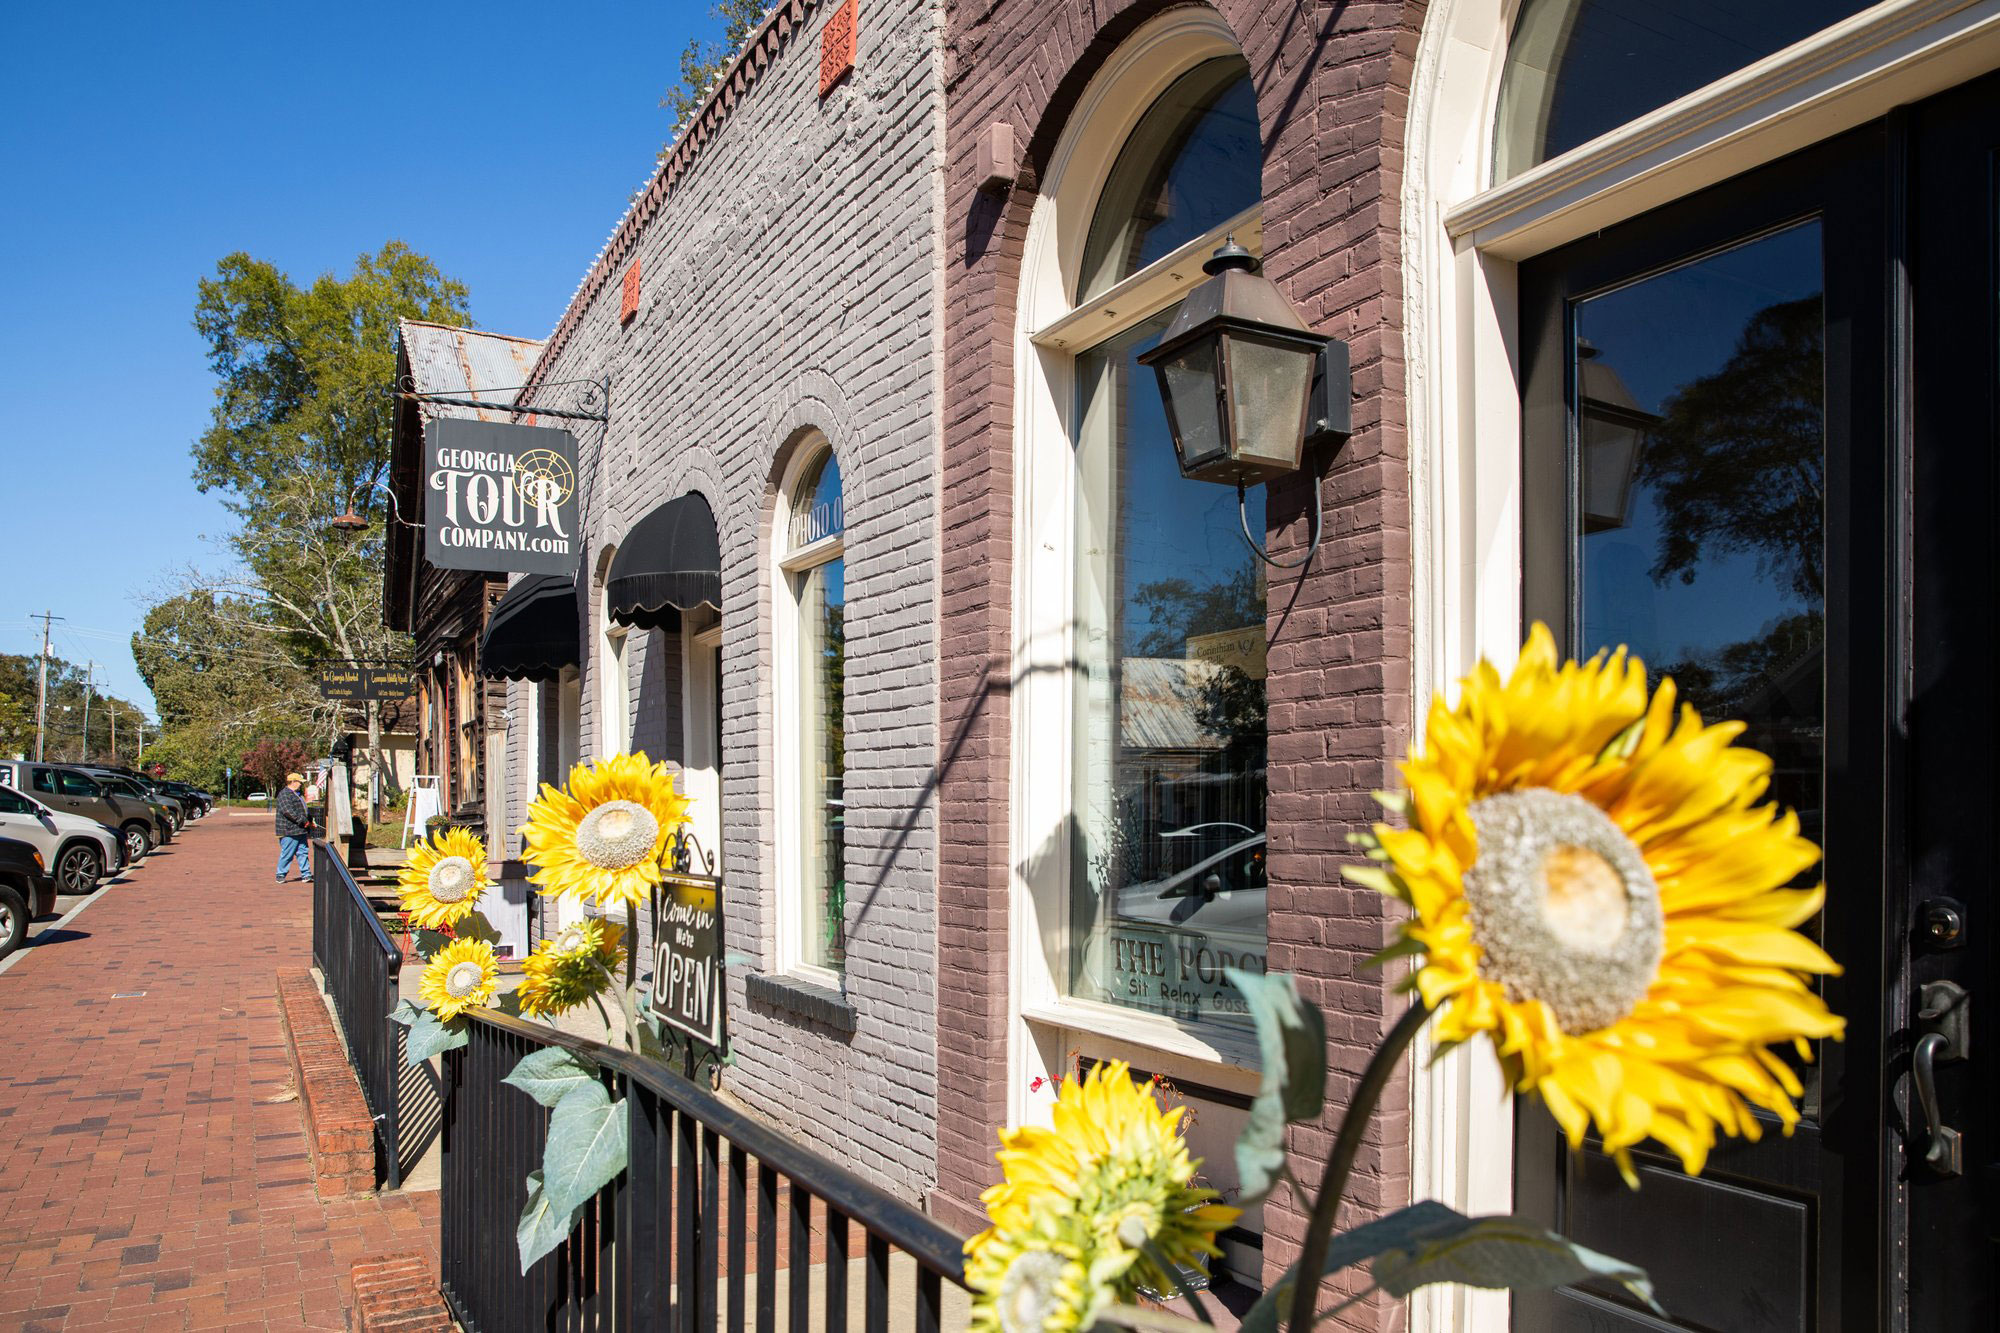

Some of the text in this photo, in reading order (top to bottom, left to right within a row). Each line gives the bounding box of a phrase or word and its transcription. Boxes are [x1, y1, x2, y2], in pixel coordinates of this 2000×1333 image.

[437, 448, 516, 473] GEORGIA
[430, 470, 569, 538] TOUR
[440, 526, 569, 554] COMPANY.com
[790, 502, 830, 549] PHOTO
[1196, 640, 1235, 658] Corinthian
[663, 894, 714, 929] Come in
[1111, 936, 1268, 989] THE PORC
[655, 942, 711, 1026] OPEN
[1129, 979, 1148, 997] Sit
[1161, 983, 1200, 1006] Relax
